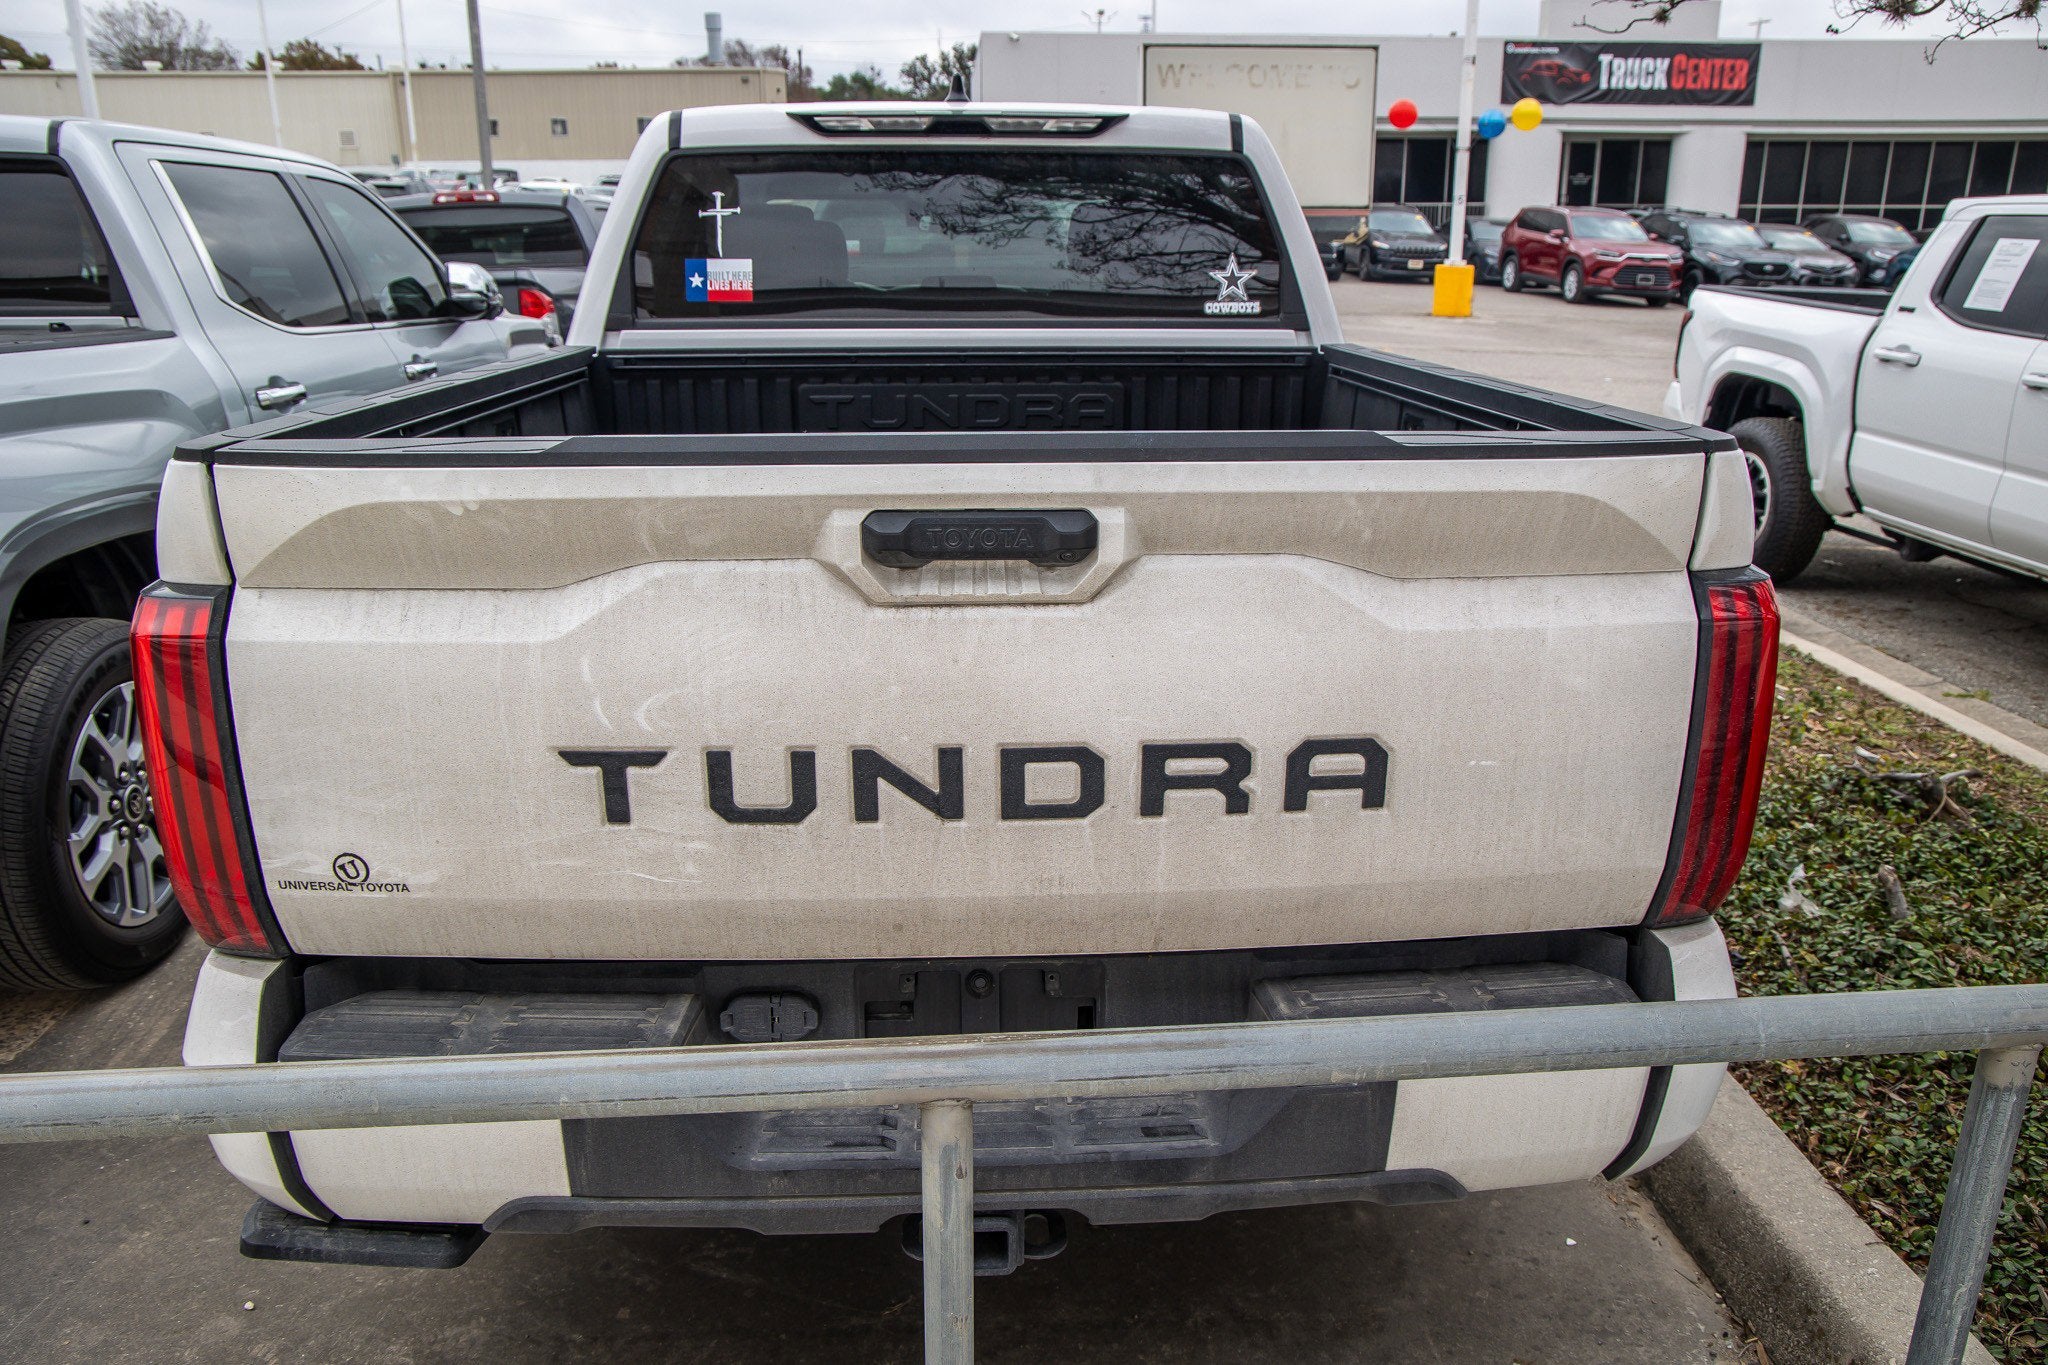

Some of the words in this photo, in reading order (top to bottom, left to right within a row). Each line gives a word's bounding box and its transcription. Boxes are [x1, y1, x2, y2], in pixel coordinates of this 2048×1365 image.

[707, 270, 731, 281] BUILT
[731, 270, 753, 281] HERE
[707, 280, 731, 291] LIVES
[731, 280, 753, 291] HERE
[1205, 302, 1261, 315] COWBOYS
[809, 393, 1115, 429] TUNDRA
[926, 528, 1034, 549] TOYOTA
[557, 738, 1390, 825] TUNDRA
[277, 880, 353, 892] UNIVERSAL
[359, 883, 411, 893] TOYOTA
